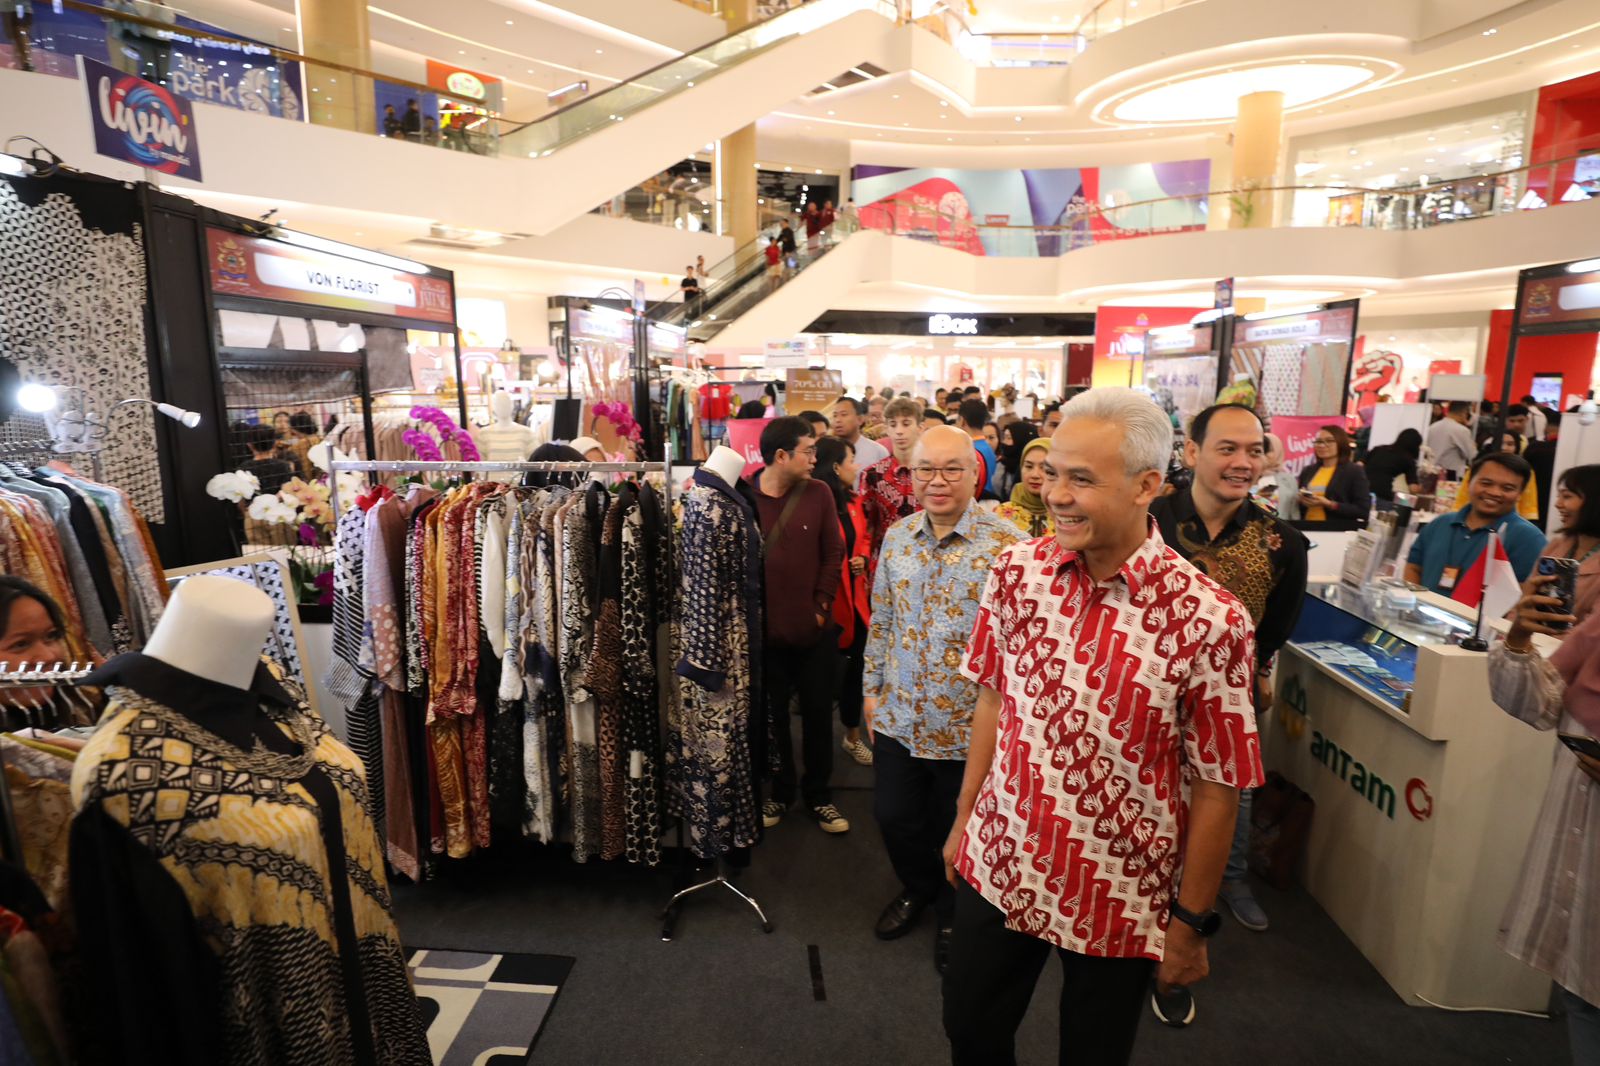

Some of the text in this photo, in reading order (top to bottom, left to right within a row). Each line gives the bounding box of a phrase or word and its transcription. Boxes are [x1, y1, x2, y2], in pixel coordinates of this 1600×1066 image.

[181, 55, 209, 75] the
[172, 70, 237, 104] park
[306, 271, 379, 295] VON FLORIST
